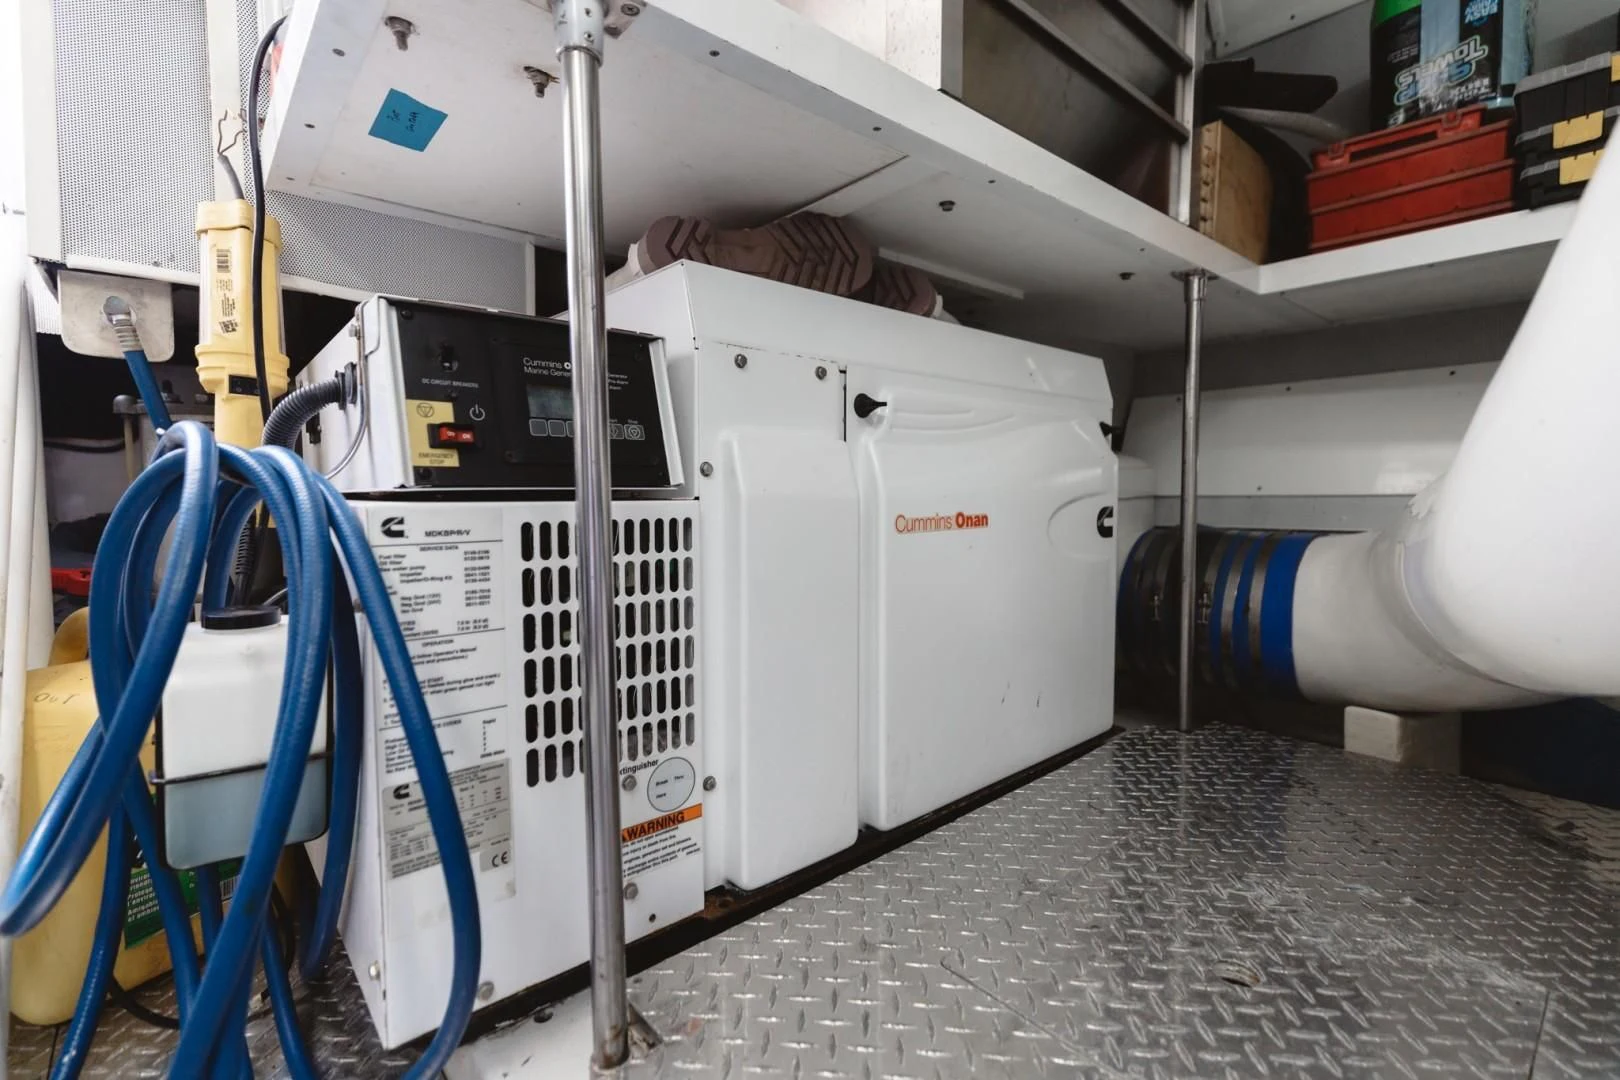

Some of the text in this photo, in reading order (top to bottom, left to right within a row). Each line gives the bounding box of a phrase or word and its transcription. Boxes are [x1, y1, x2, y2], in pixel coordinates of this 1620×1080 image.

[523, 357, 562, 370] Cummins
[524, 366, 572, 378] Marine Gener
[895, 511, 988, 534] Cummins Onan
[627, 812, 685, 840] WARNING
